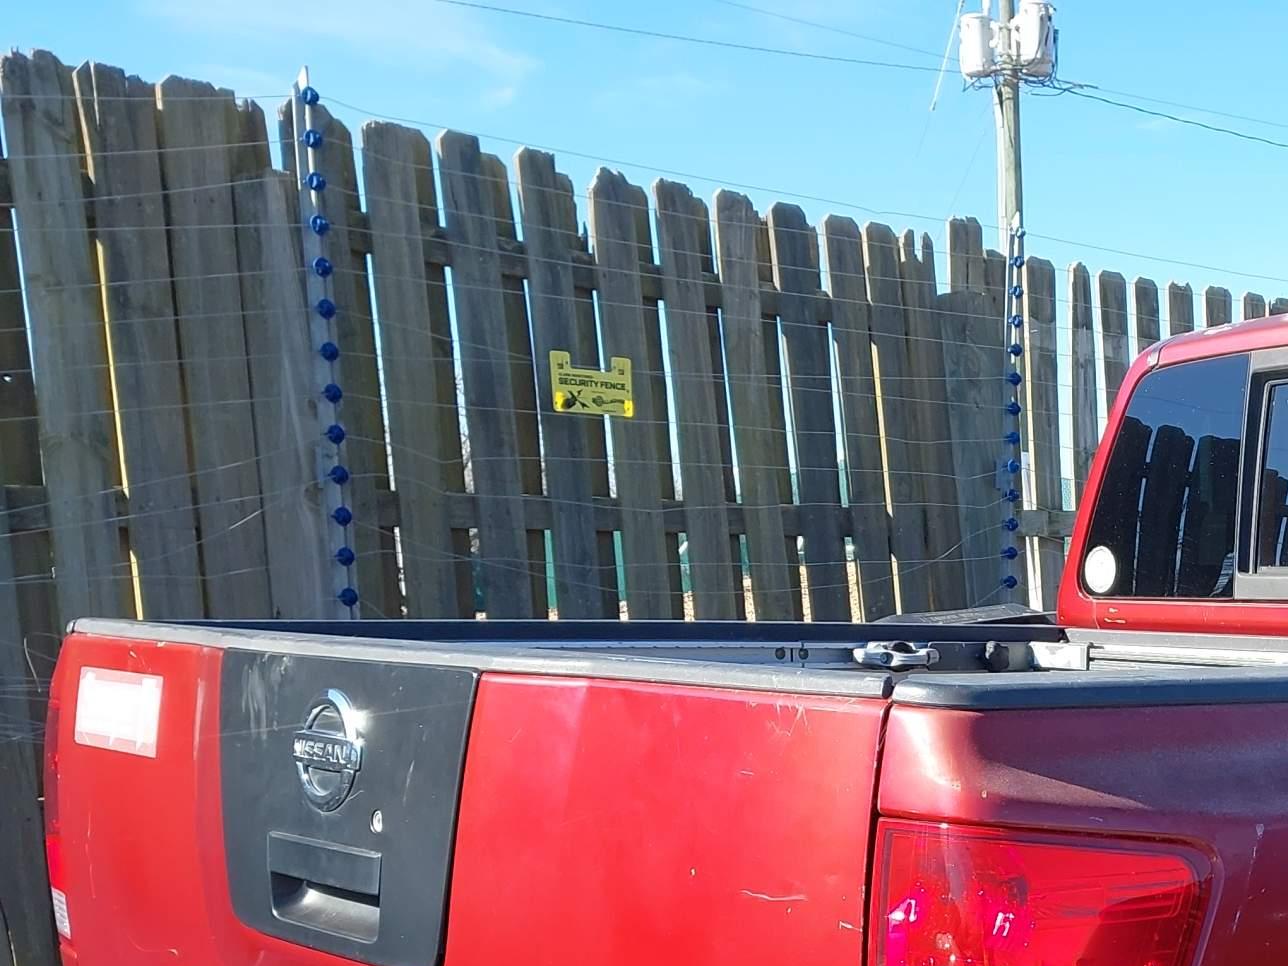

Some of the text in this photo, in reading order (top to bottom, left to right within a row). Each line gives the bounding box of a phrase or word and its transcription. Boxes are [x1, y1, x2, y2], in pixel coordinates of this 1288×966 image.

[558, 377, 626, 391] SECURITY FENCE
[294, 738, 347, 765] NISSAN
